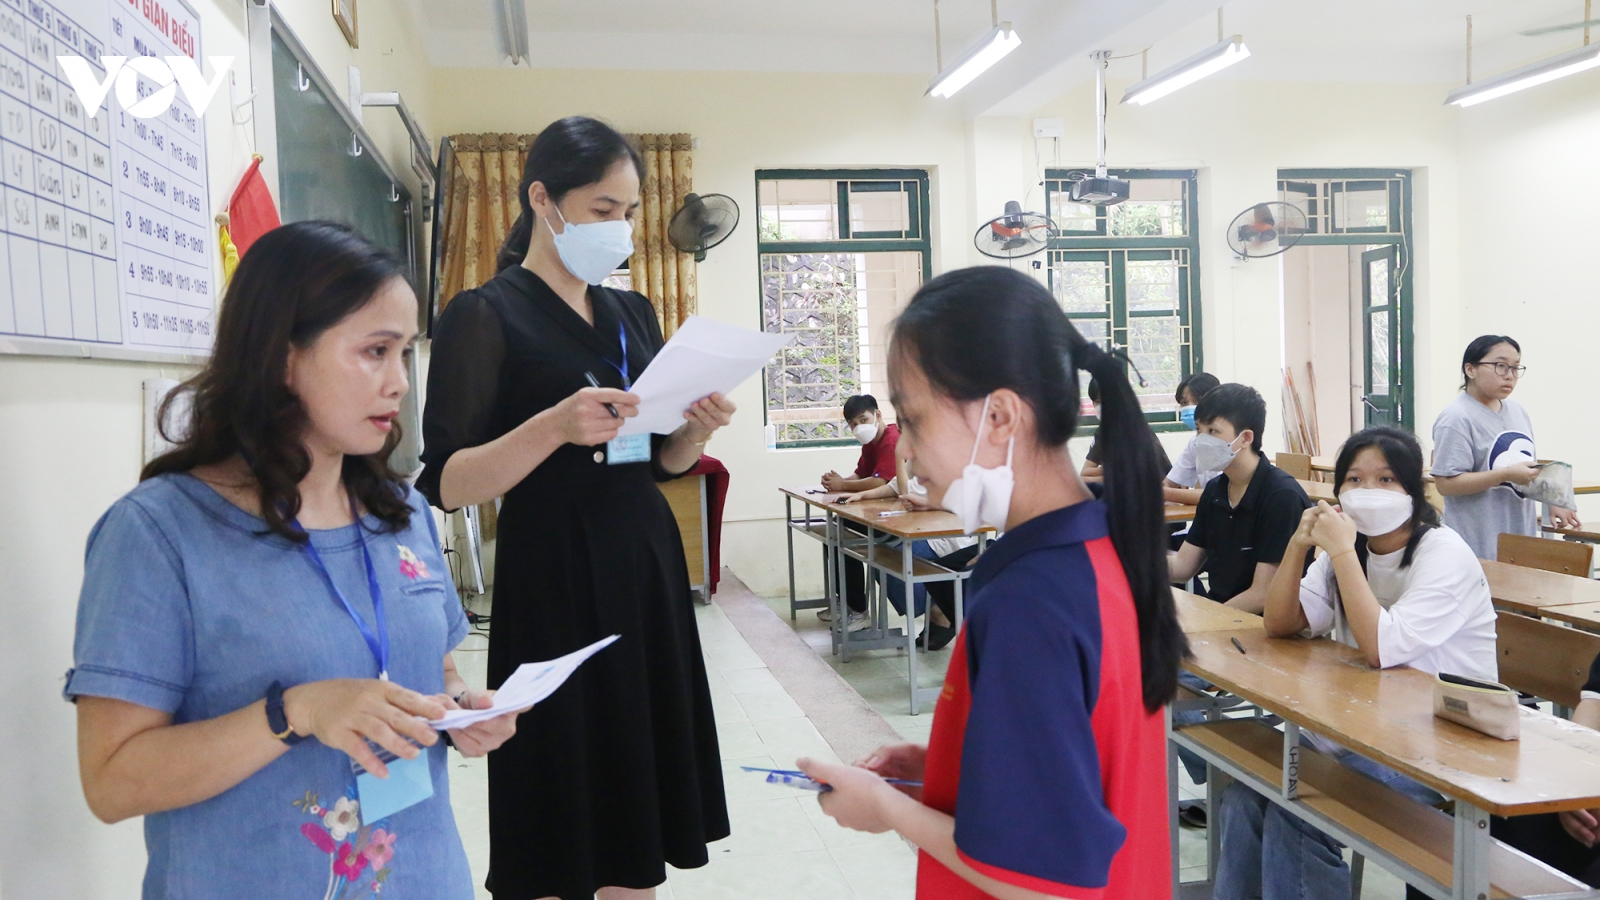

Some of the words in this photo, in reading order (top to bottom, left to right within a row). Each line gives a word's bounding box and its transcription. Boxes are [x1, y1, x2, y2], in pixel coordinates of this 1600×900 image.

[142, 0, 169, 38] GIAN
[171, 19, 195, 60] BIỂU
[120, 111, 126, 128] 1
[122, 160, 129, 179] 2
[125, 210, 132, 229] 3
[128, 261, 135, 279] 4
[132, 310, 139, 329] 5
